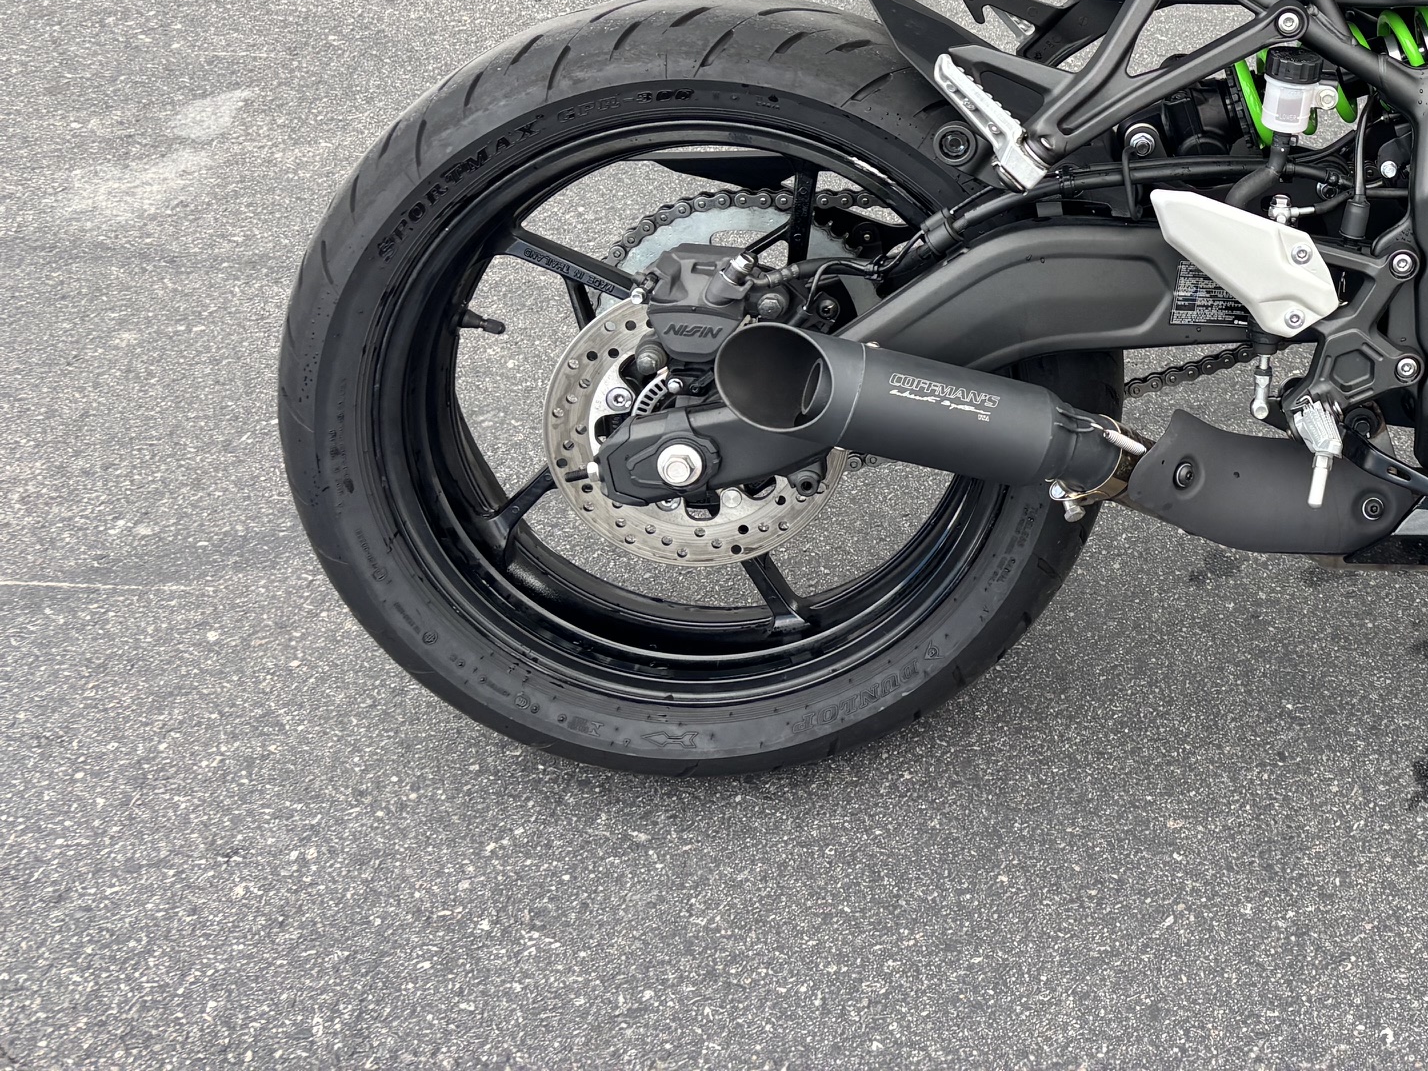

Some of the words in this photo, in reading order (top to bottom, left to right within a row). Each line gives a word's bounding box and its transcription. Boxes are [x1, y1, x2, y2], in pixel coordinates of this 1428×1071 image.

[1279, 113, 1297, 121] LOWER
[376, 118, 542, 263] SPORTMAX
[523, 247, 571, 275] THAILAND
[573, 270, 585, 282] IN
[586, 274, 615, 294] MADE
[888, 372, 1001, 408] COFFMAN'S
[791, 658, 920, 735] DUNLOP
